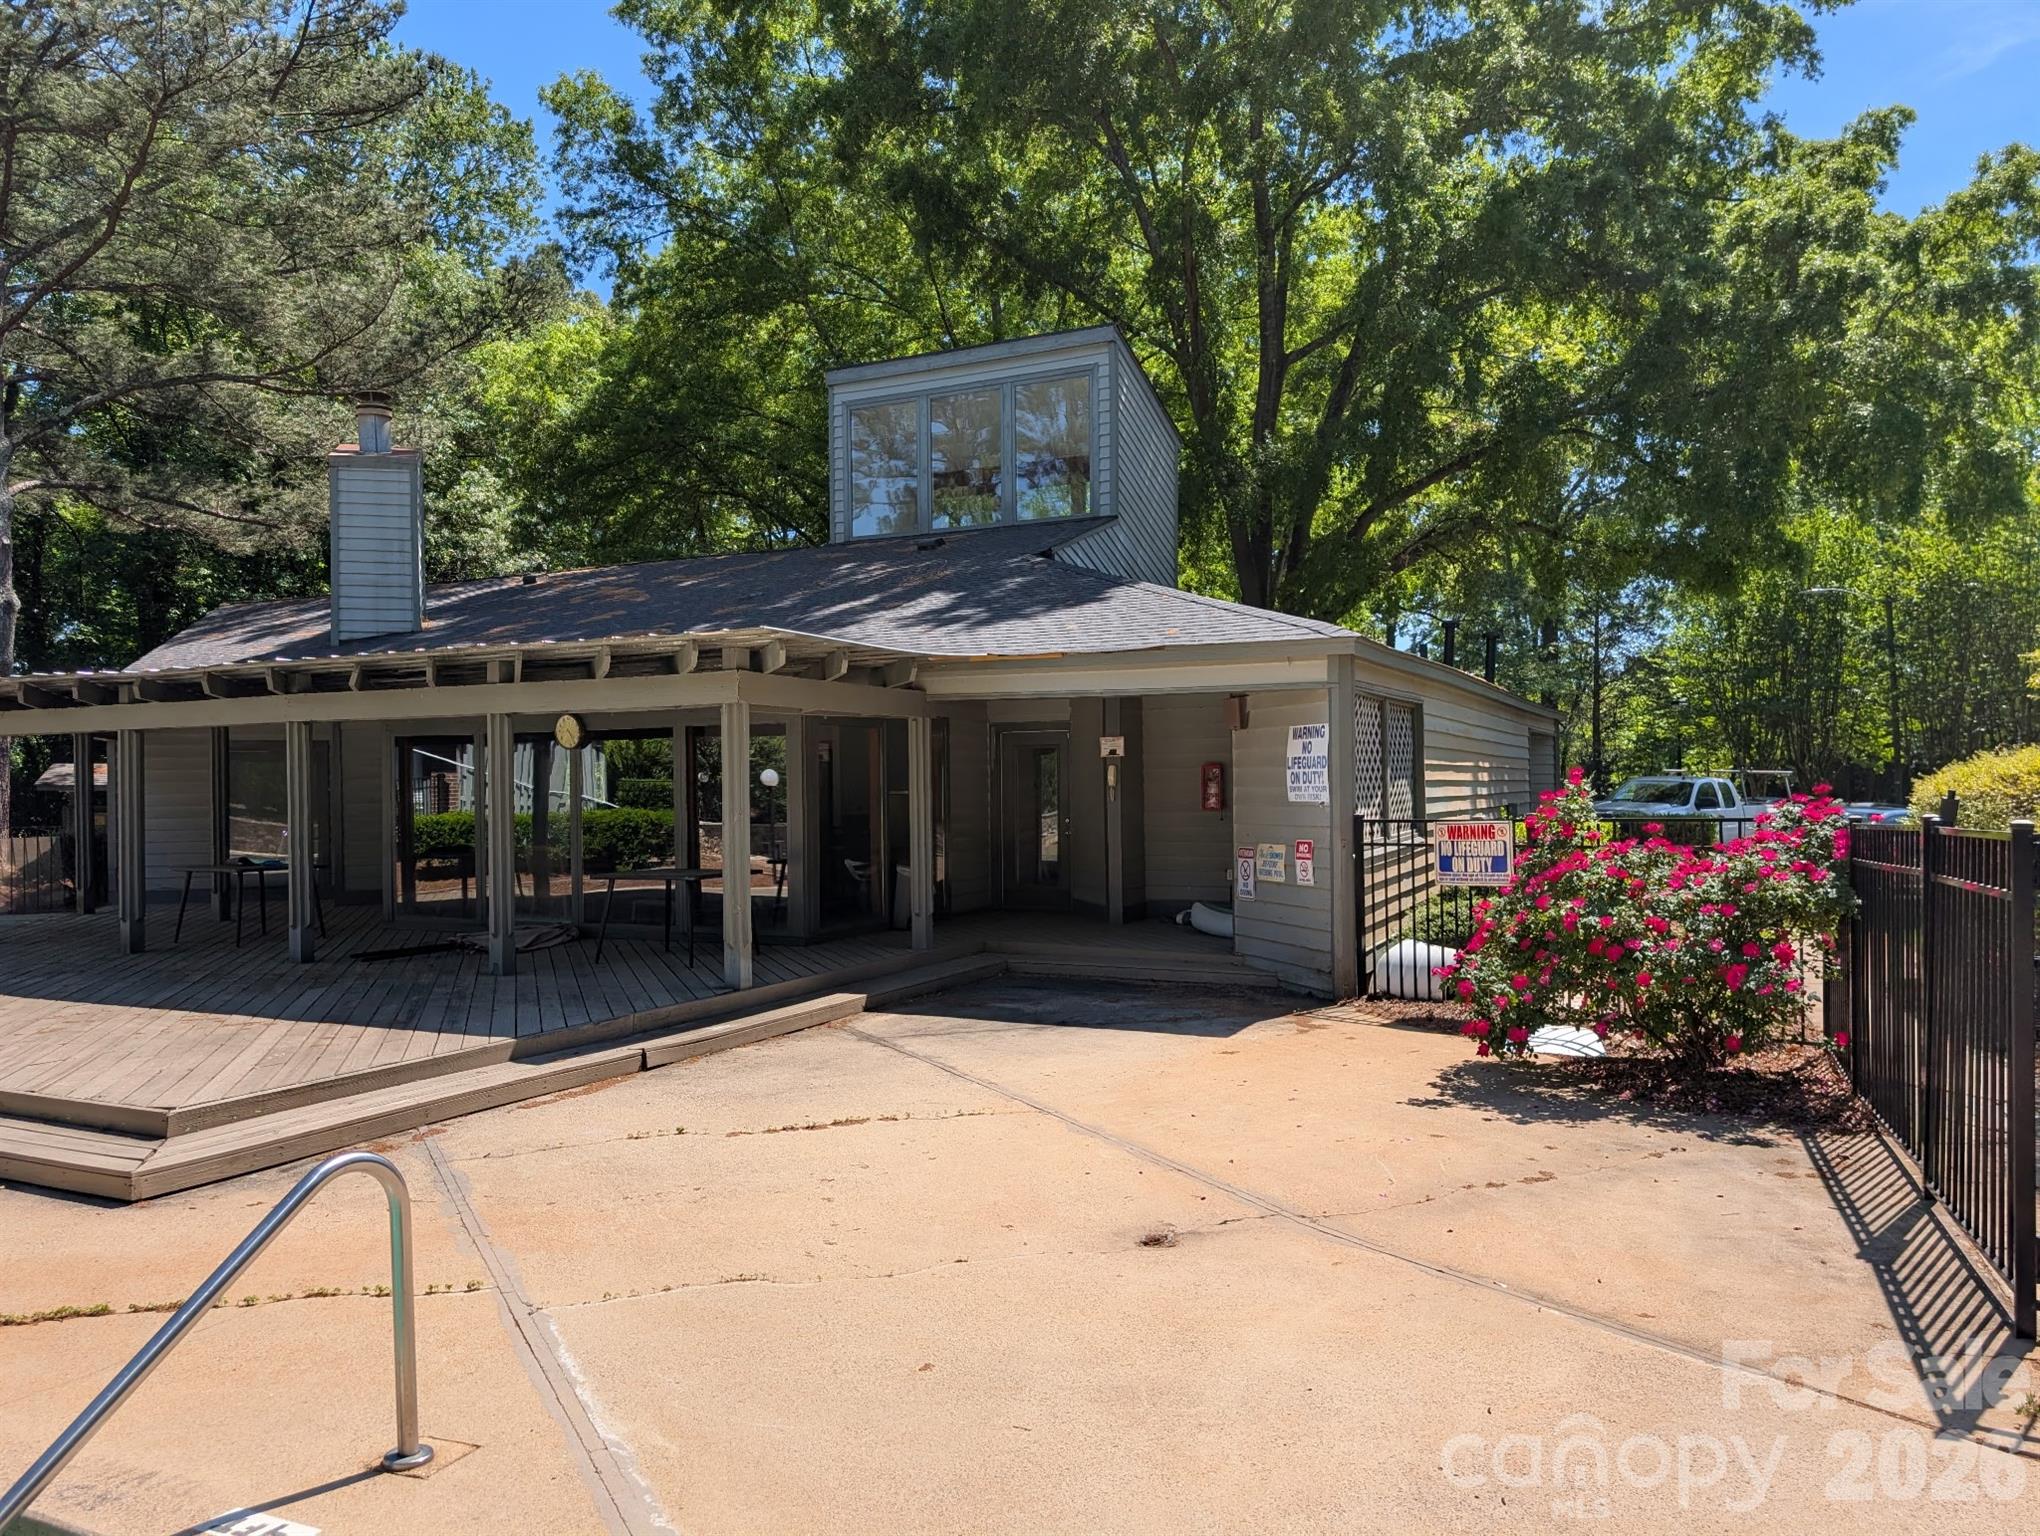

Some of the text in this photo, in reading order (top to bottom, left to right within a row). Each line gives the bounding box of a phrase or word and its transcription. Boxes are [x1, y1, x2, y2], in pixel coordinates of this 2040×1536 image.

[1293, 725, 1326, 740] WARNING
[1302, 741, 1312, 754] NO
[1287, 755, 1328, 770] LIFEGUARD
[1290, 770, 1325, 785] ON DUTY!
[1289, 785, 1328, 793] SWIM AT YOUR
[1446, 824, 1496, 841] WARNING
[1298, 842, 1309, 853] NO
[1440, 840, 1505, 857] NO LIFEGUARD
[1451, 856, 1493, 873] ON DUTY
